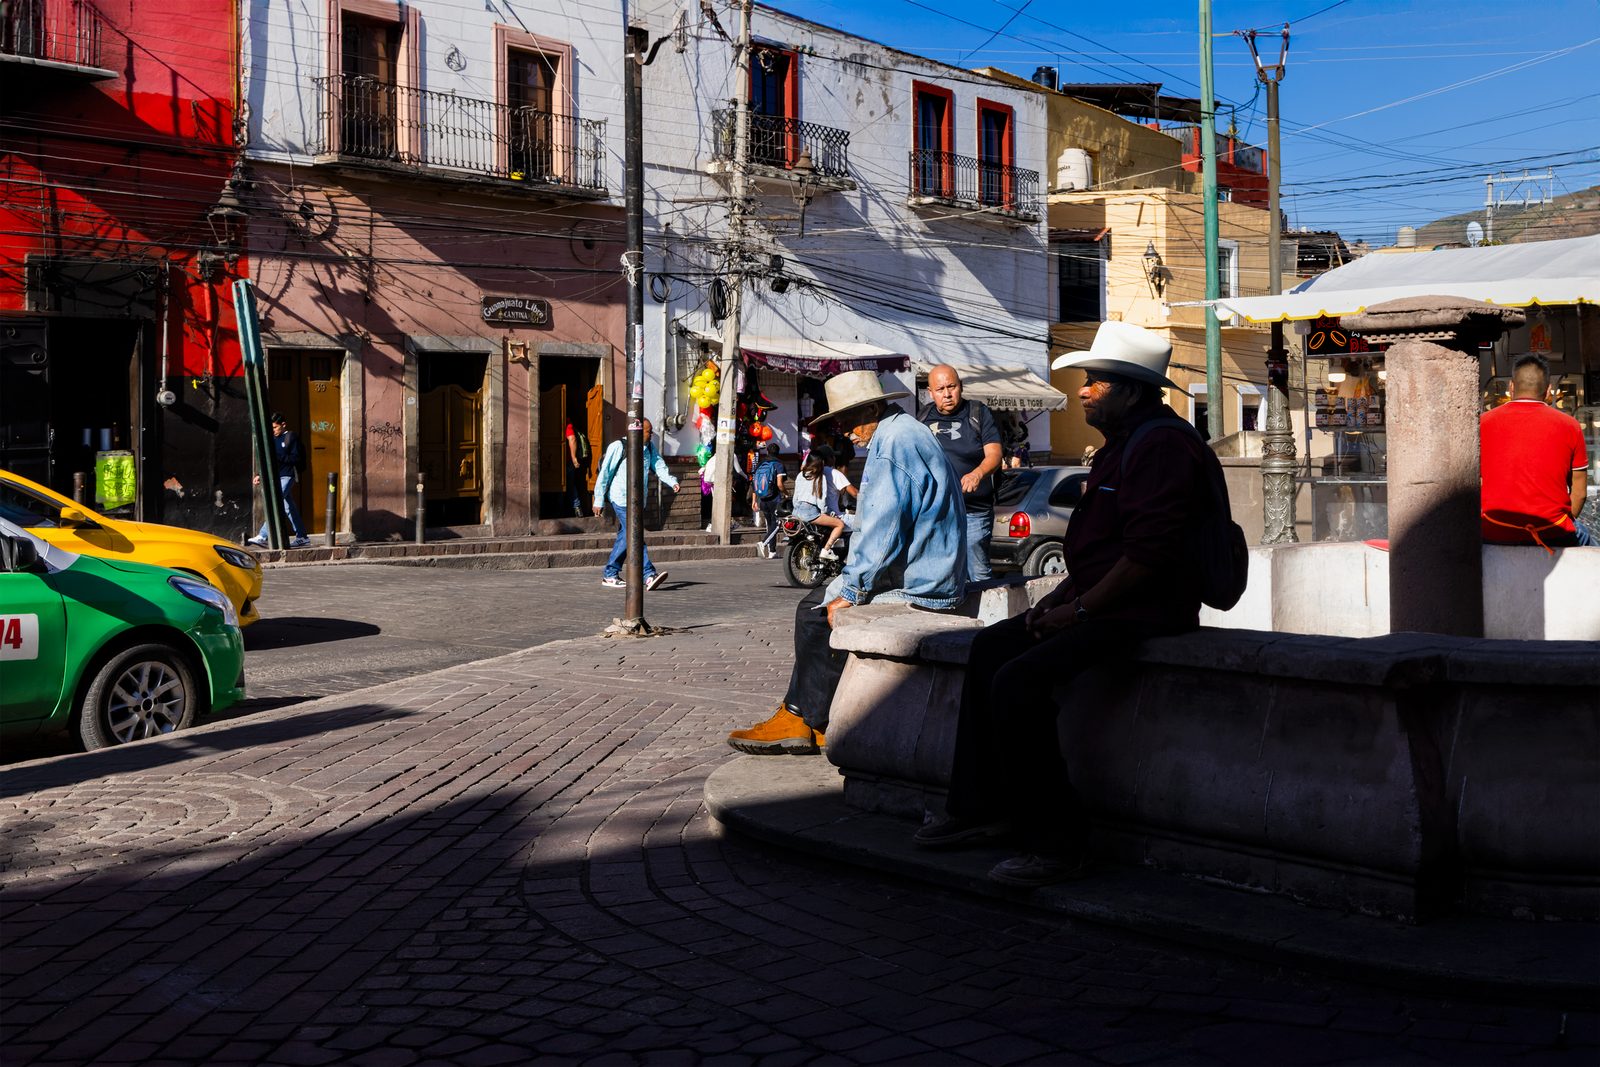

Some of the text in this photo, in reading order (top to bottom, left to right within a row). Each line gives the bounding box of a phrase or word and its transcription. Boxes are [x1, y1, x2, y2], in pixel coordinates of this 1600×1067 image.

[483, 299, 544, 318] Guanajuato Libre
[504, 311, 528, 319] CANTINA
[1020, 399, 1026, 407] EL
